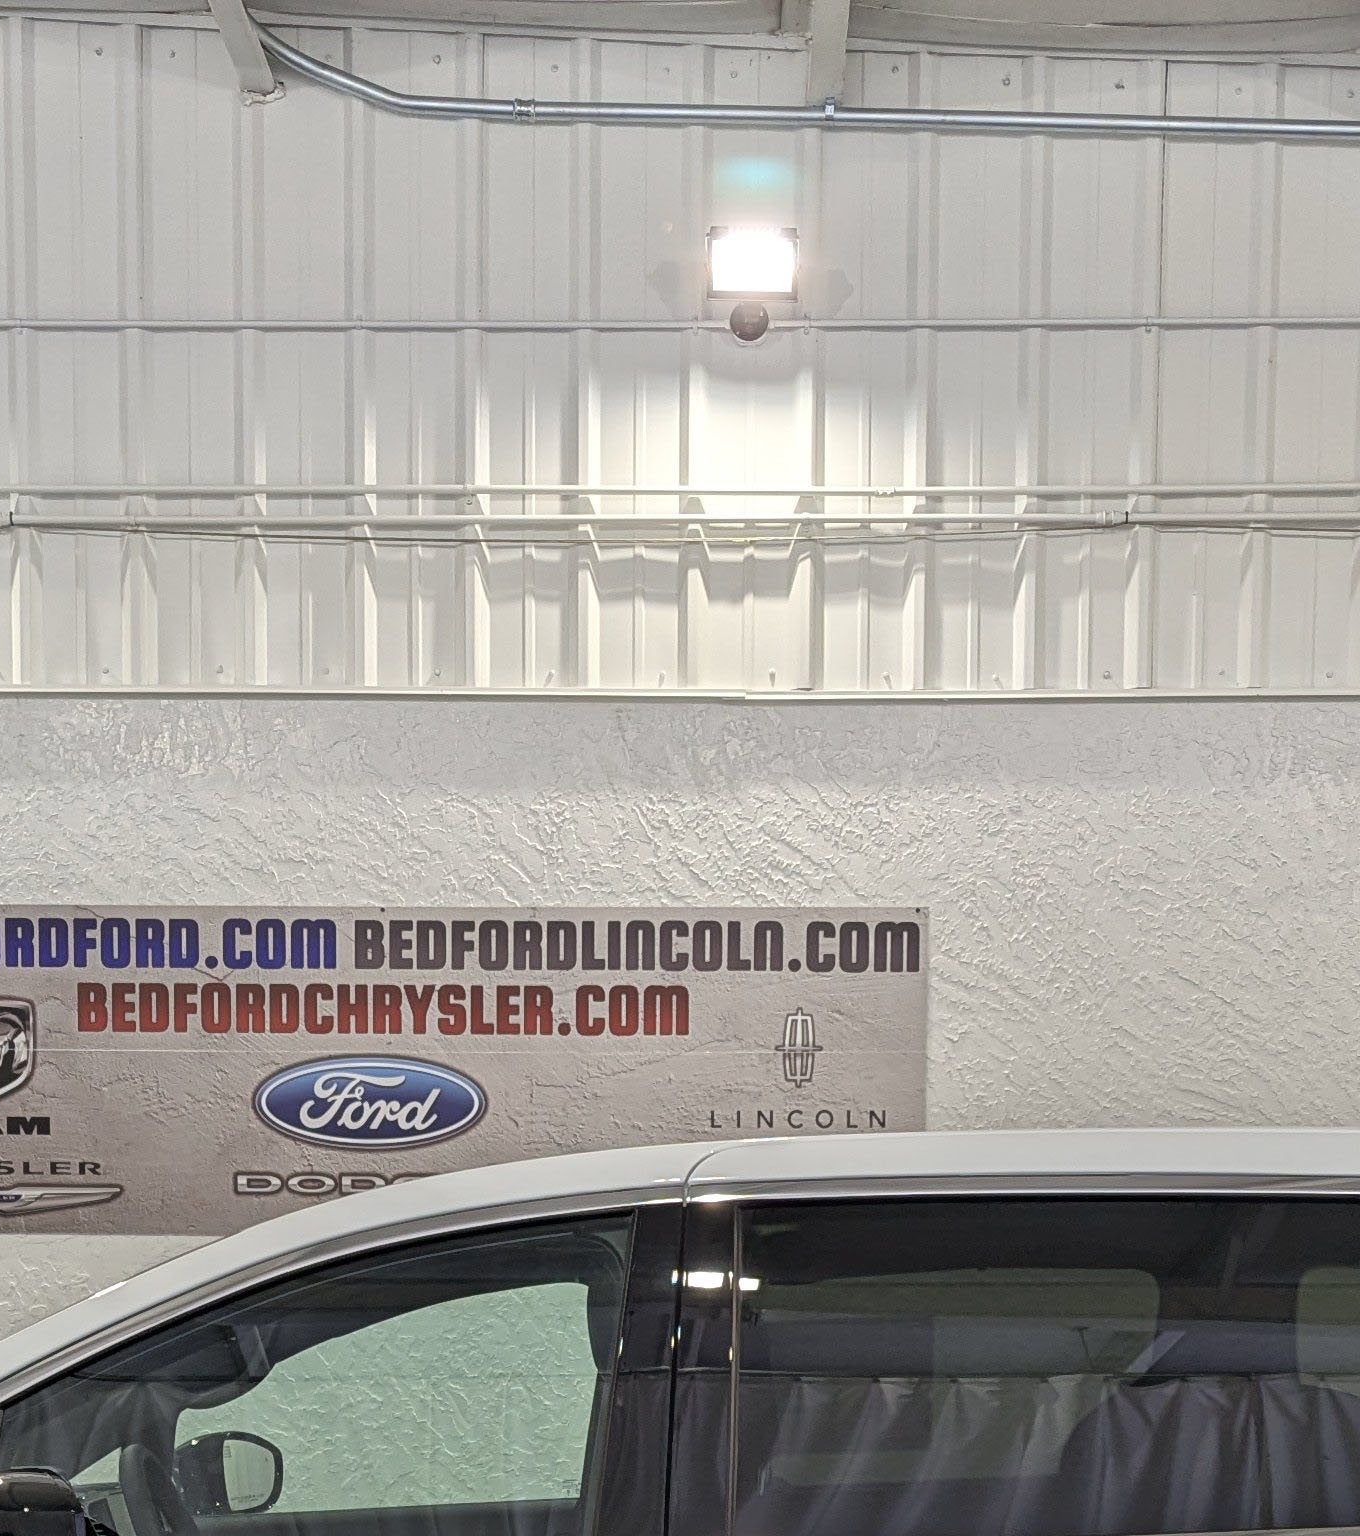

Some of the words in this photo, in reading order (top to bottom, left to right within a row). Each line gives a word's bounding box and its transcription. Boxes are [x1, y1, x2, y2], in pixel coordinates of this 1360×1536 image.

[353, 919, 920, 974] BEDFORDLINCOLN.COM
[76, 981, 689, 1037] BEDFORDCHRYSLER.COM
[300, 1073, 439, 1134] Ford
[710, 1110, 887, 1129] LINCOLN
[234, 1172, 436, 1196] DOD
